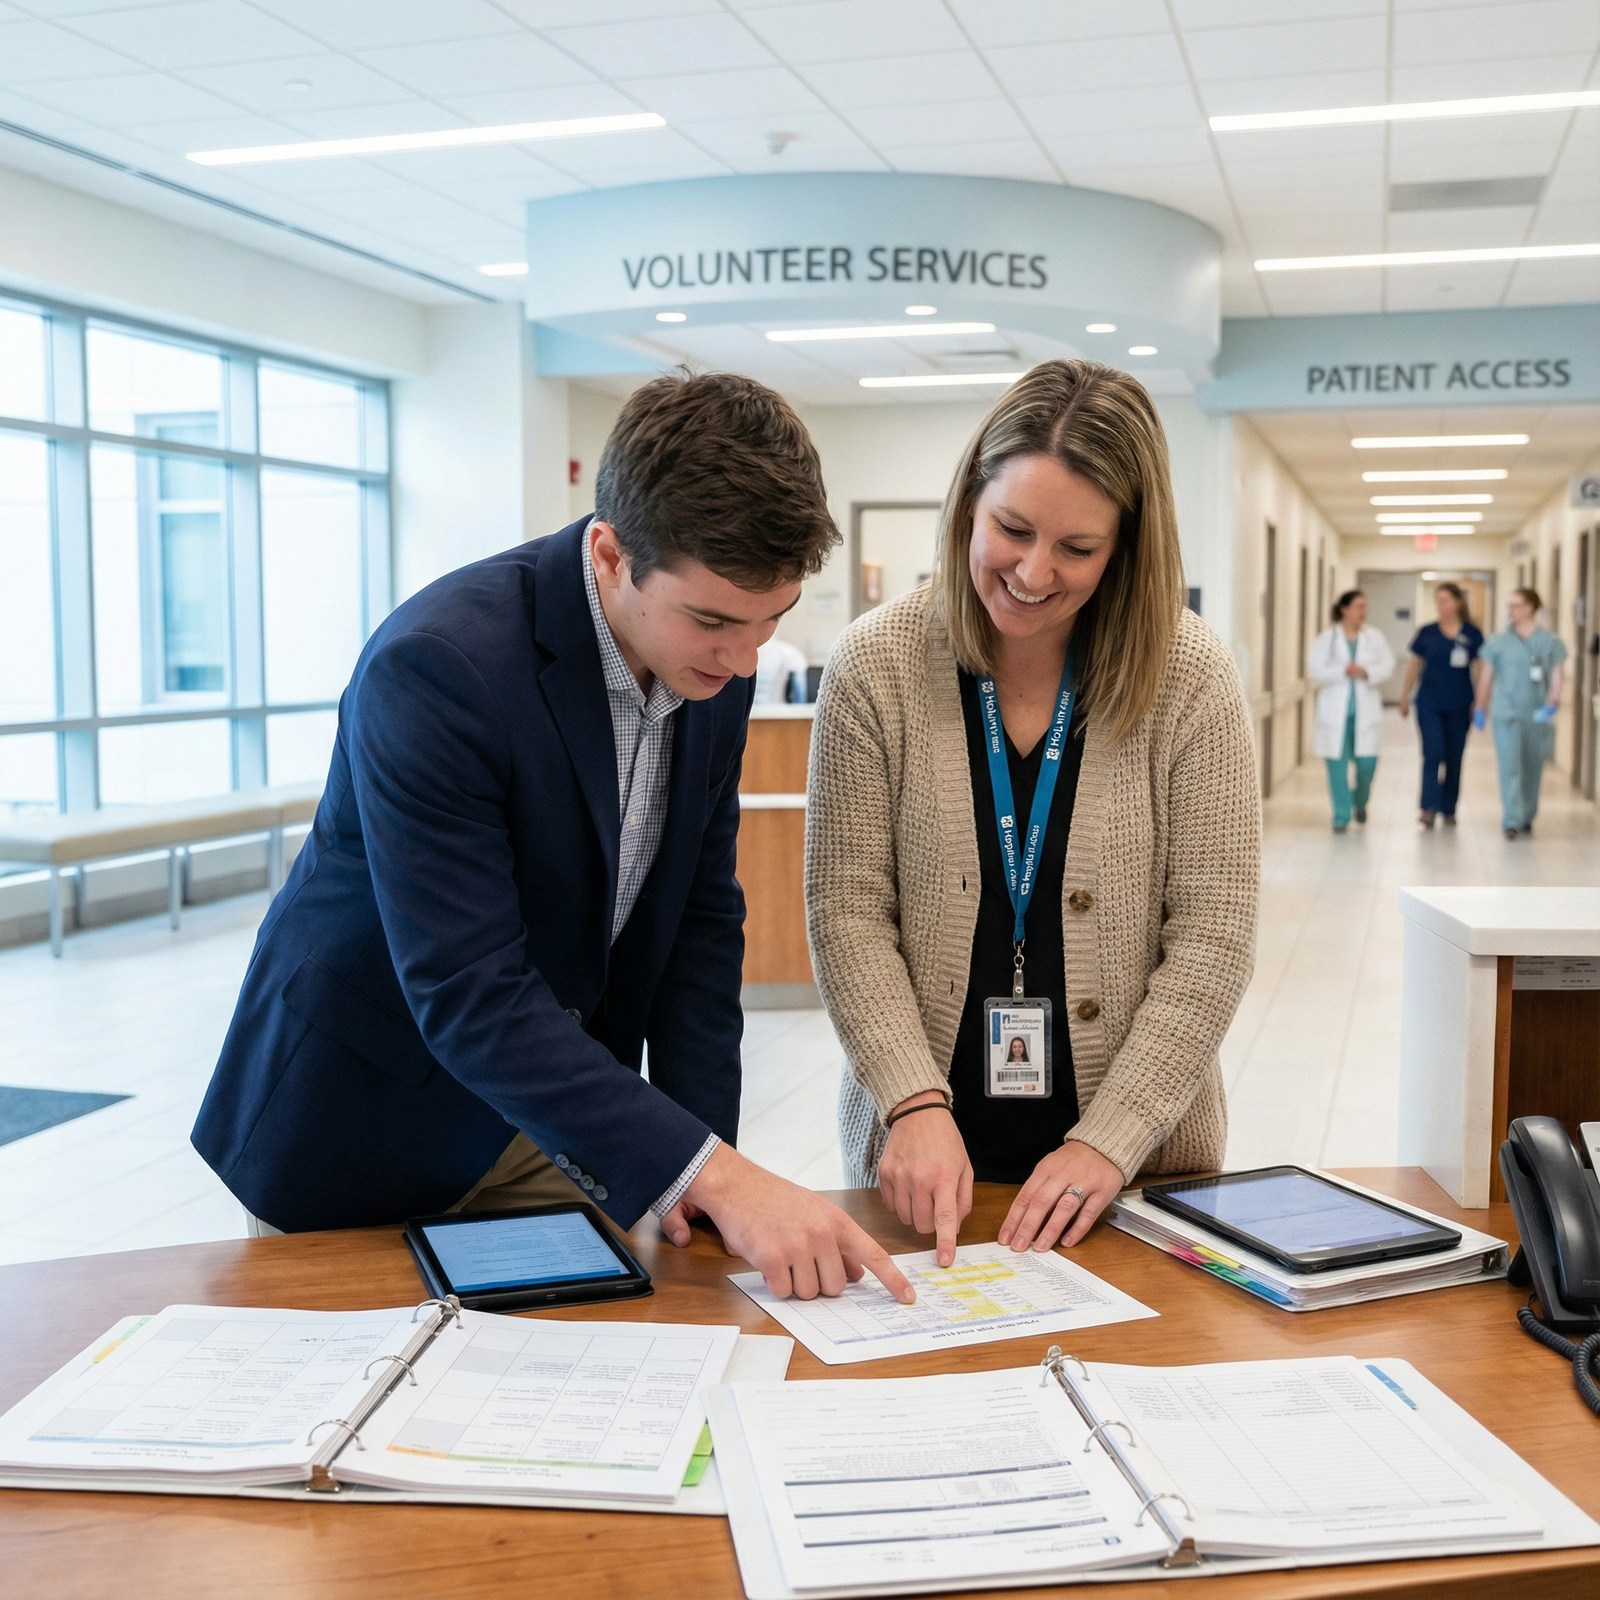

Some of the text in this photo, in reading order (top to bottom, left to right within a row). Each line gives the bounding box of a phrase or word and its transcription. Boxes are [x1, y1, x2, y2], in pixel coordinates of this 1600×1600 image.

[622, 246, 1048, 290] VOLUNTEER SERVICES
[1307, 359, 1572, 394] PATIENT ACCESS
